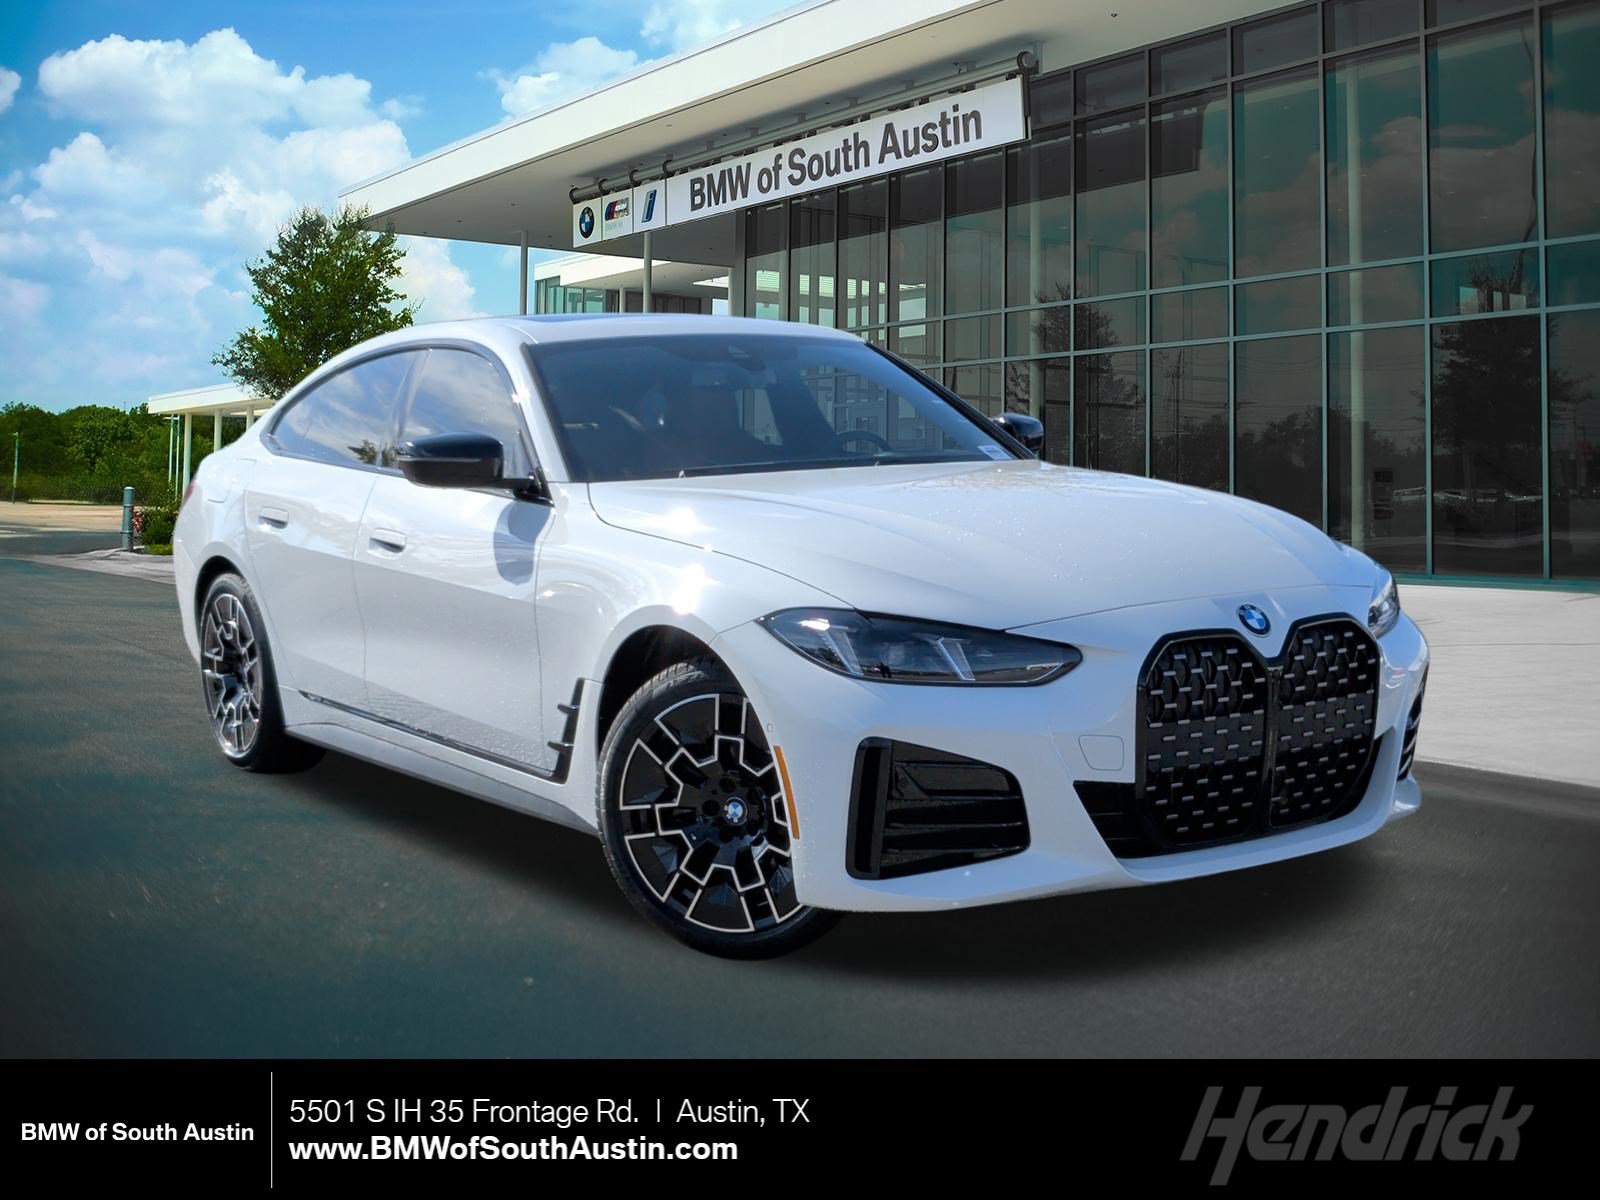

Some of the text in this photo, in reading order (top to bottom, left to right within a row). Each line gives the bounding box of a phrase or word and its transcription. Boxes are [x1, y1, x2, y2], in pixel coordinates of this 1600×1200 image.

[690, 104, 983, 212] BMW of South Austin
